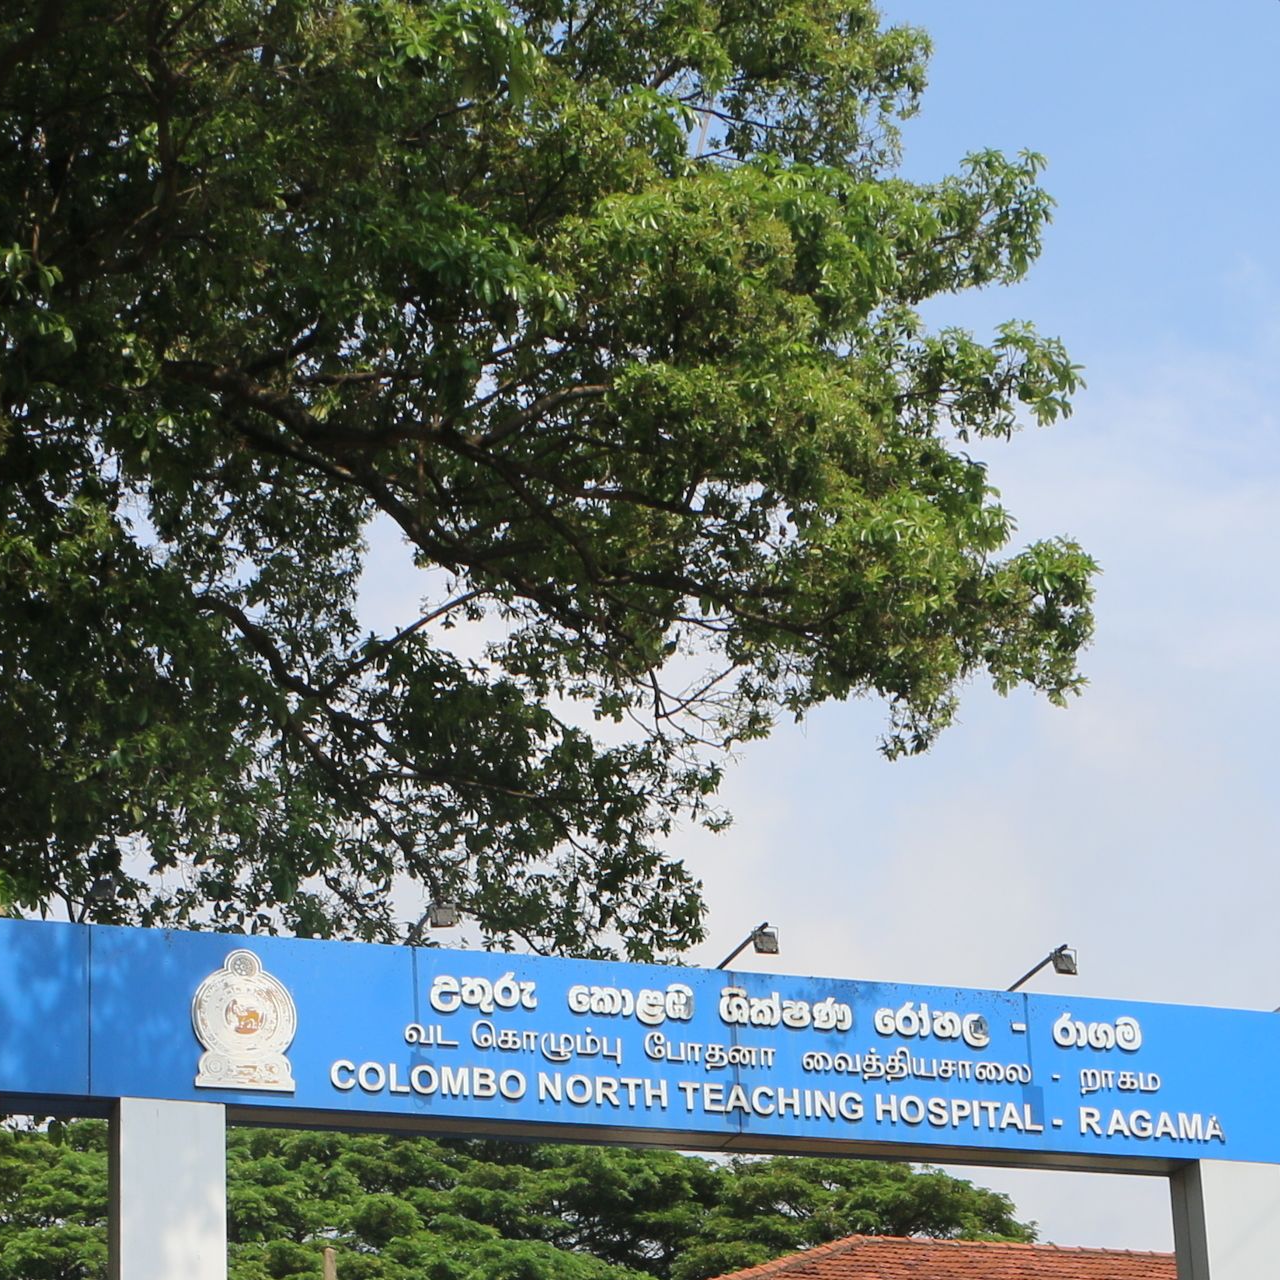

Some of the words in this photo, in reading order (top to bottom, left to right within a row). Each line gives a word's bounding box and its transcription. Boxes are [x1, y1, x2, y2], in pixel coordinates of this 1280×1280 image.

[430, 972, 537, 1013] උතුරු
[568, 983, 695, 1024] කොළඹ
[875, 1002, 991, 1047] රෝහල
[1013, 1023, 1027, 1031] -
[1053, 1013, 1143, 1051] රාගම
[404, 1022, 460, 1045] வட
[471, 1020, 622, 1065] கொழும்பு
[644, 1031, 777, 1070] போதனா
[802, 1047, 1032, 1083] வைத்தியசாலை
[1080, 1068, 1161, 1094] றாகம
[330, 1060, 527, 1099] COLOMBO
[538, 1072, 667, 1107] NORTH
[678, 1082, 865, 1120] TEACHING
[875, 1094, 1044, 1131] HOSPITAL
[1052, 1118, 1063, 1126] -
[1079, 1107, 1225, 1141] RAGAMA
